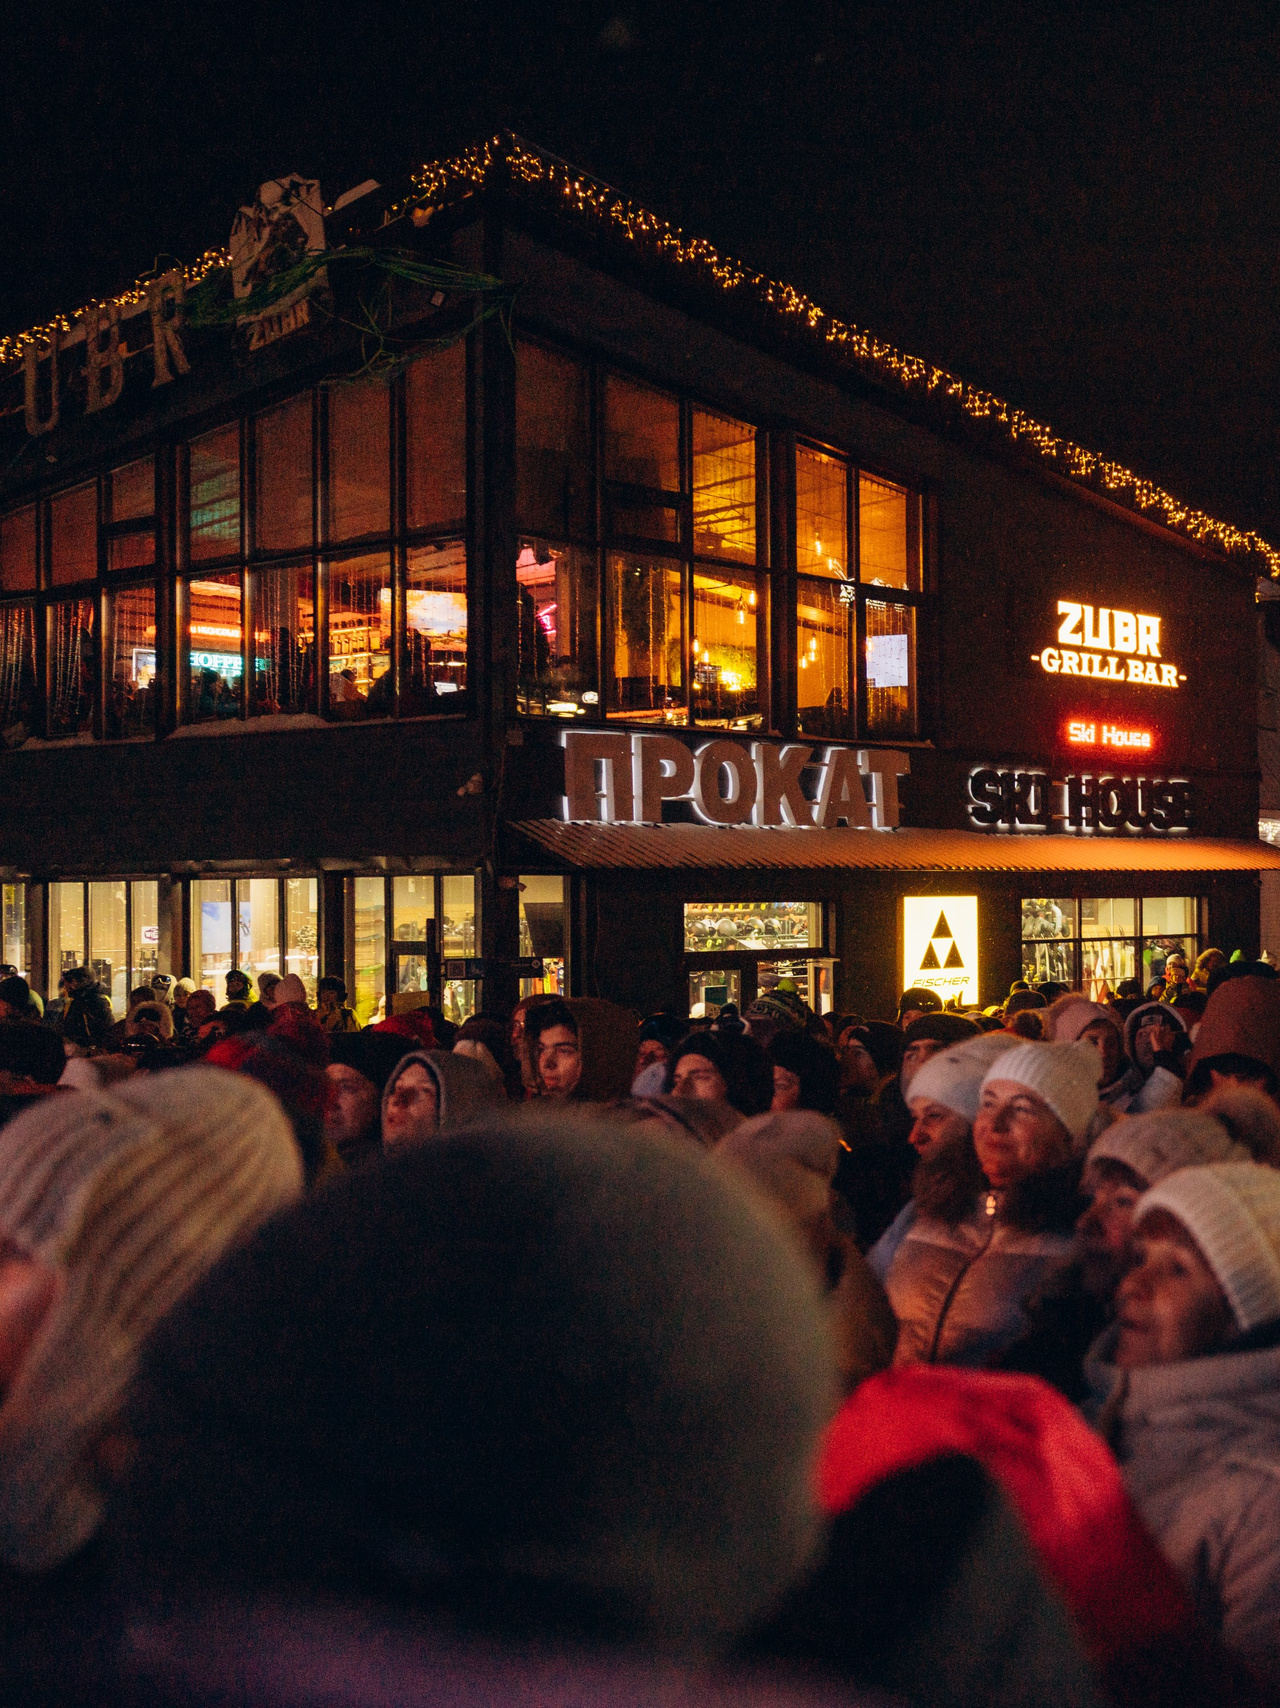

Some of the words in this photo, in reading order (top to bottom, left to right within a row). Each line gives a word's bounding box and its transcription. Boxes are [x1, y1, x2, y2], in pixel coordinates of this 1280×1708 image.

[1057, 600, 1162, 658] ZUBR
[1069, 722, 1095, 743] Ski
[1102, 725, 1151, 748] House
[561, 729, 911, 832] ПРОКАТ
[968, 767, 1048, 829] SKI
[1064, 773, 1192, 832] HOUSE
[912, 976, 970, 988] FISCHER
